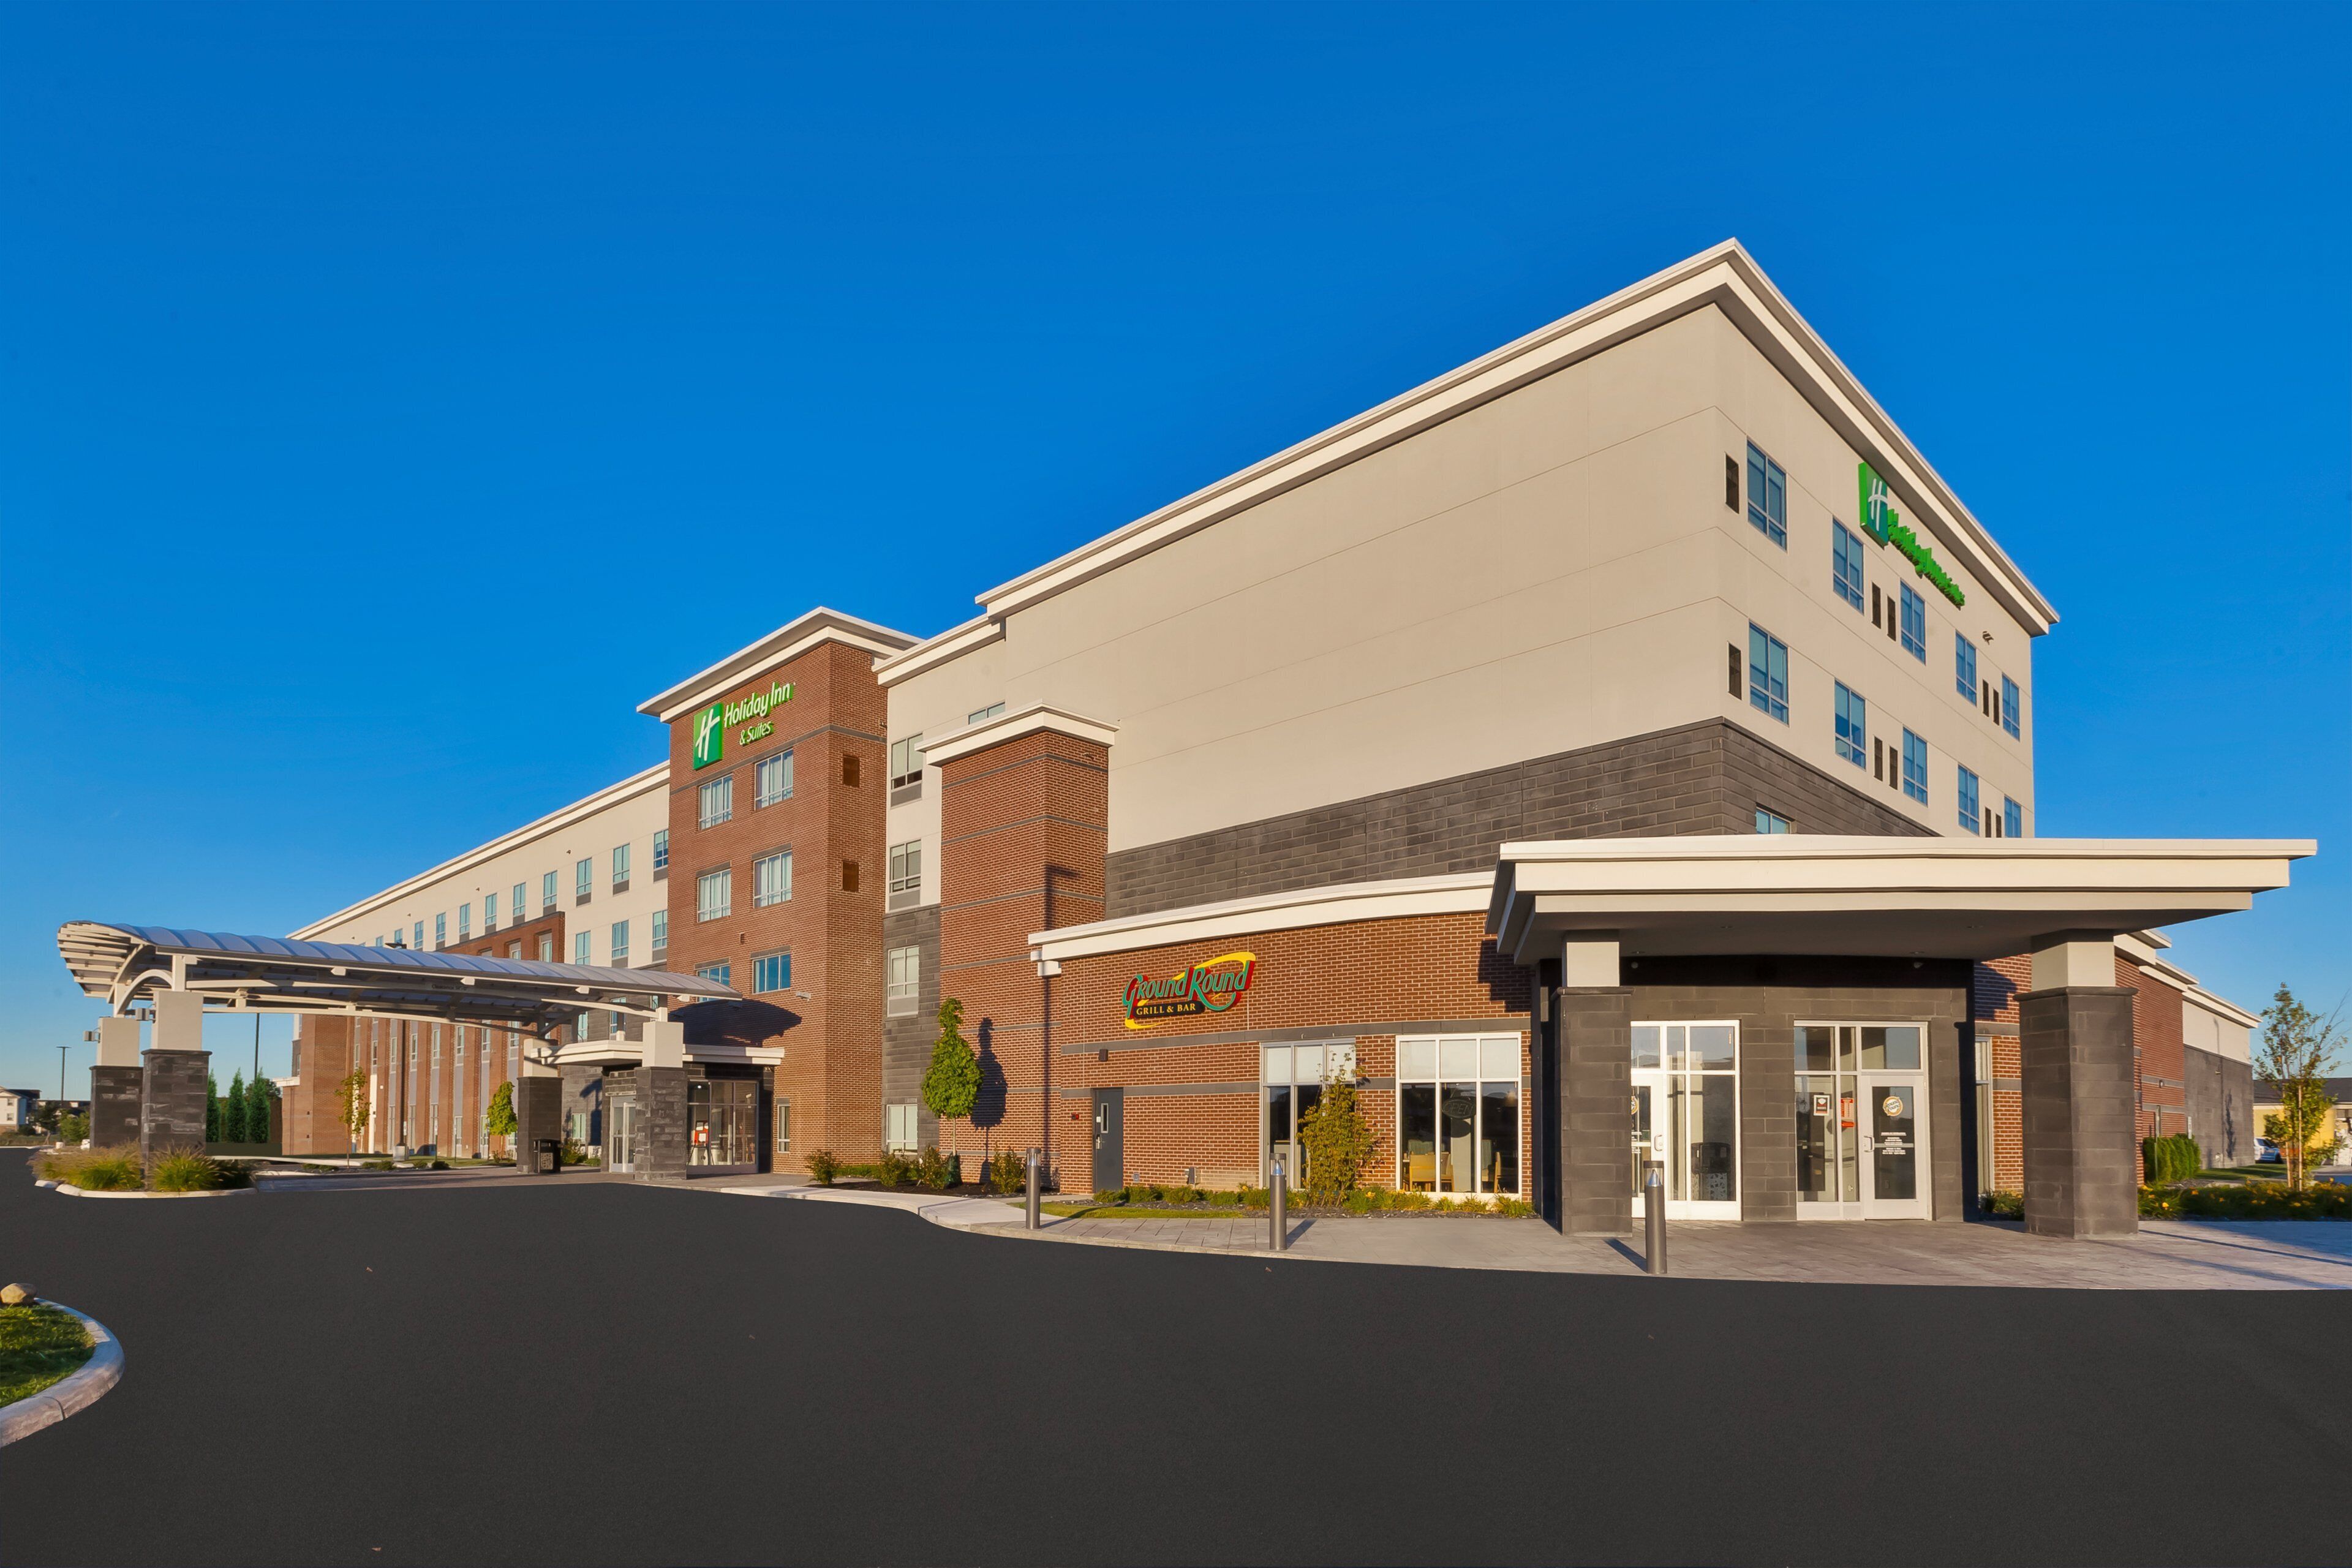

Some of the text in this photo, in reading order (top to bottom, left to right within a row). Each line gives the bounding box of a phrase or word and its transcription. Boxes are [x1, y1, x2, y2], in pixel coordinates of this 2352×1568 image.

[724, 681, 791, 728] Holiday Inn
[739, 721, 772, 745] & Suites
[1136, 1006, 1164, 1016] GRILL
[1443, 1102, 1474, 1115] OPEN
